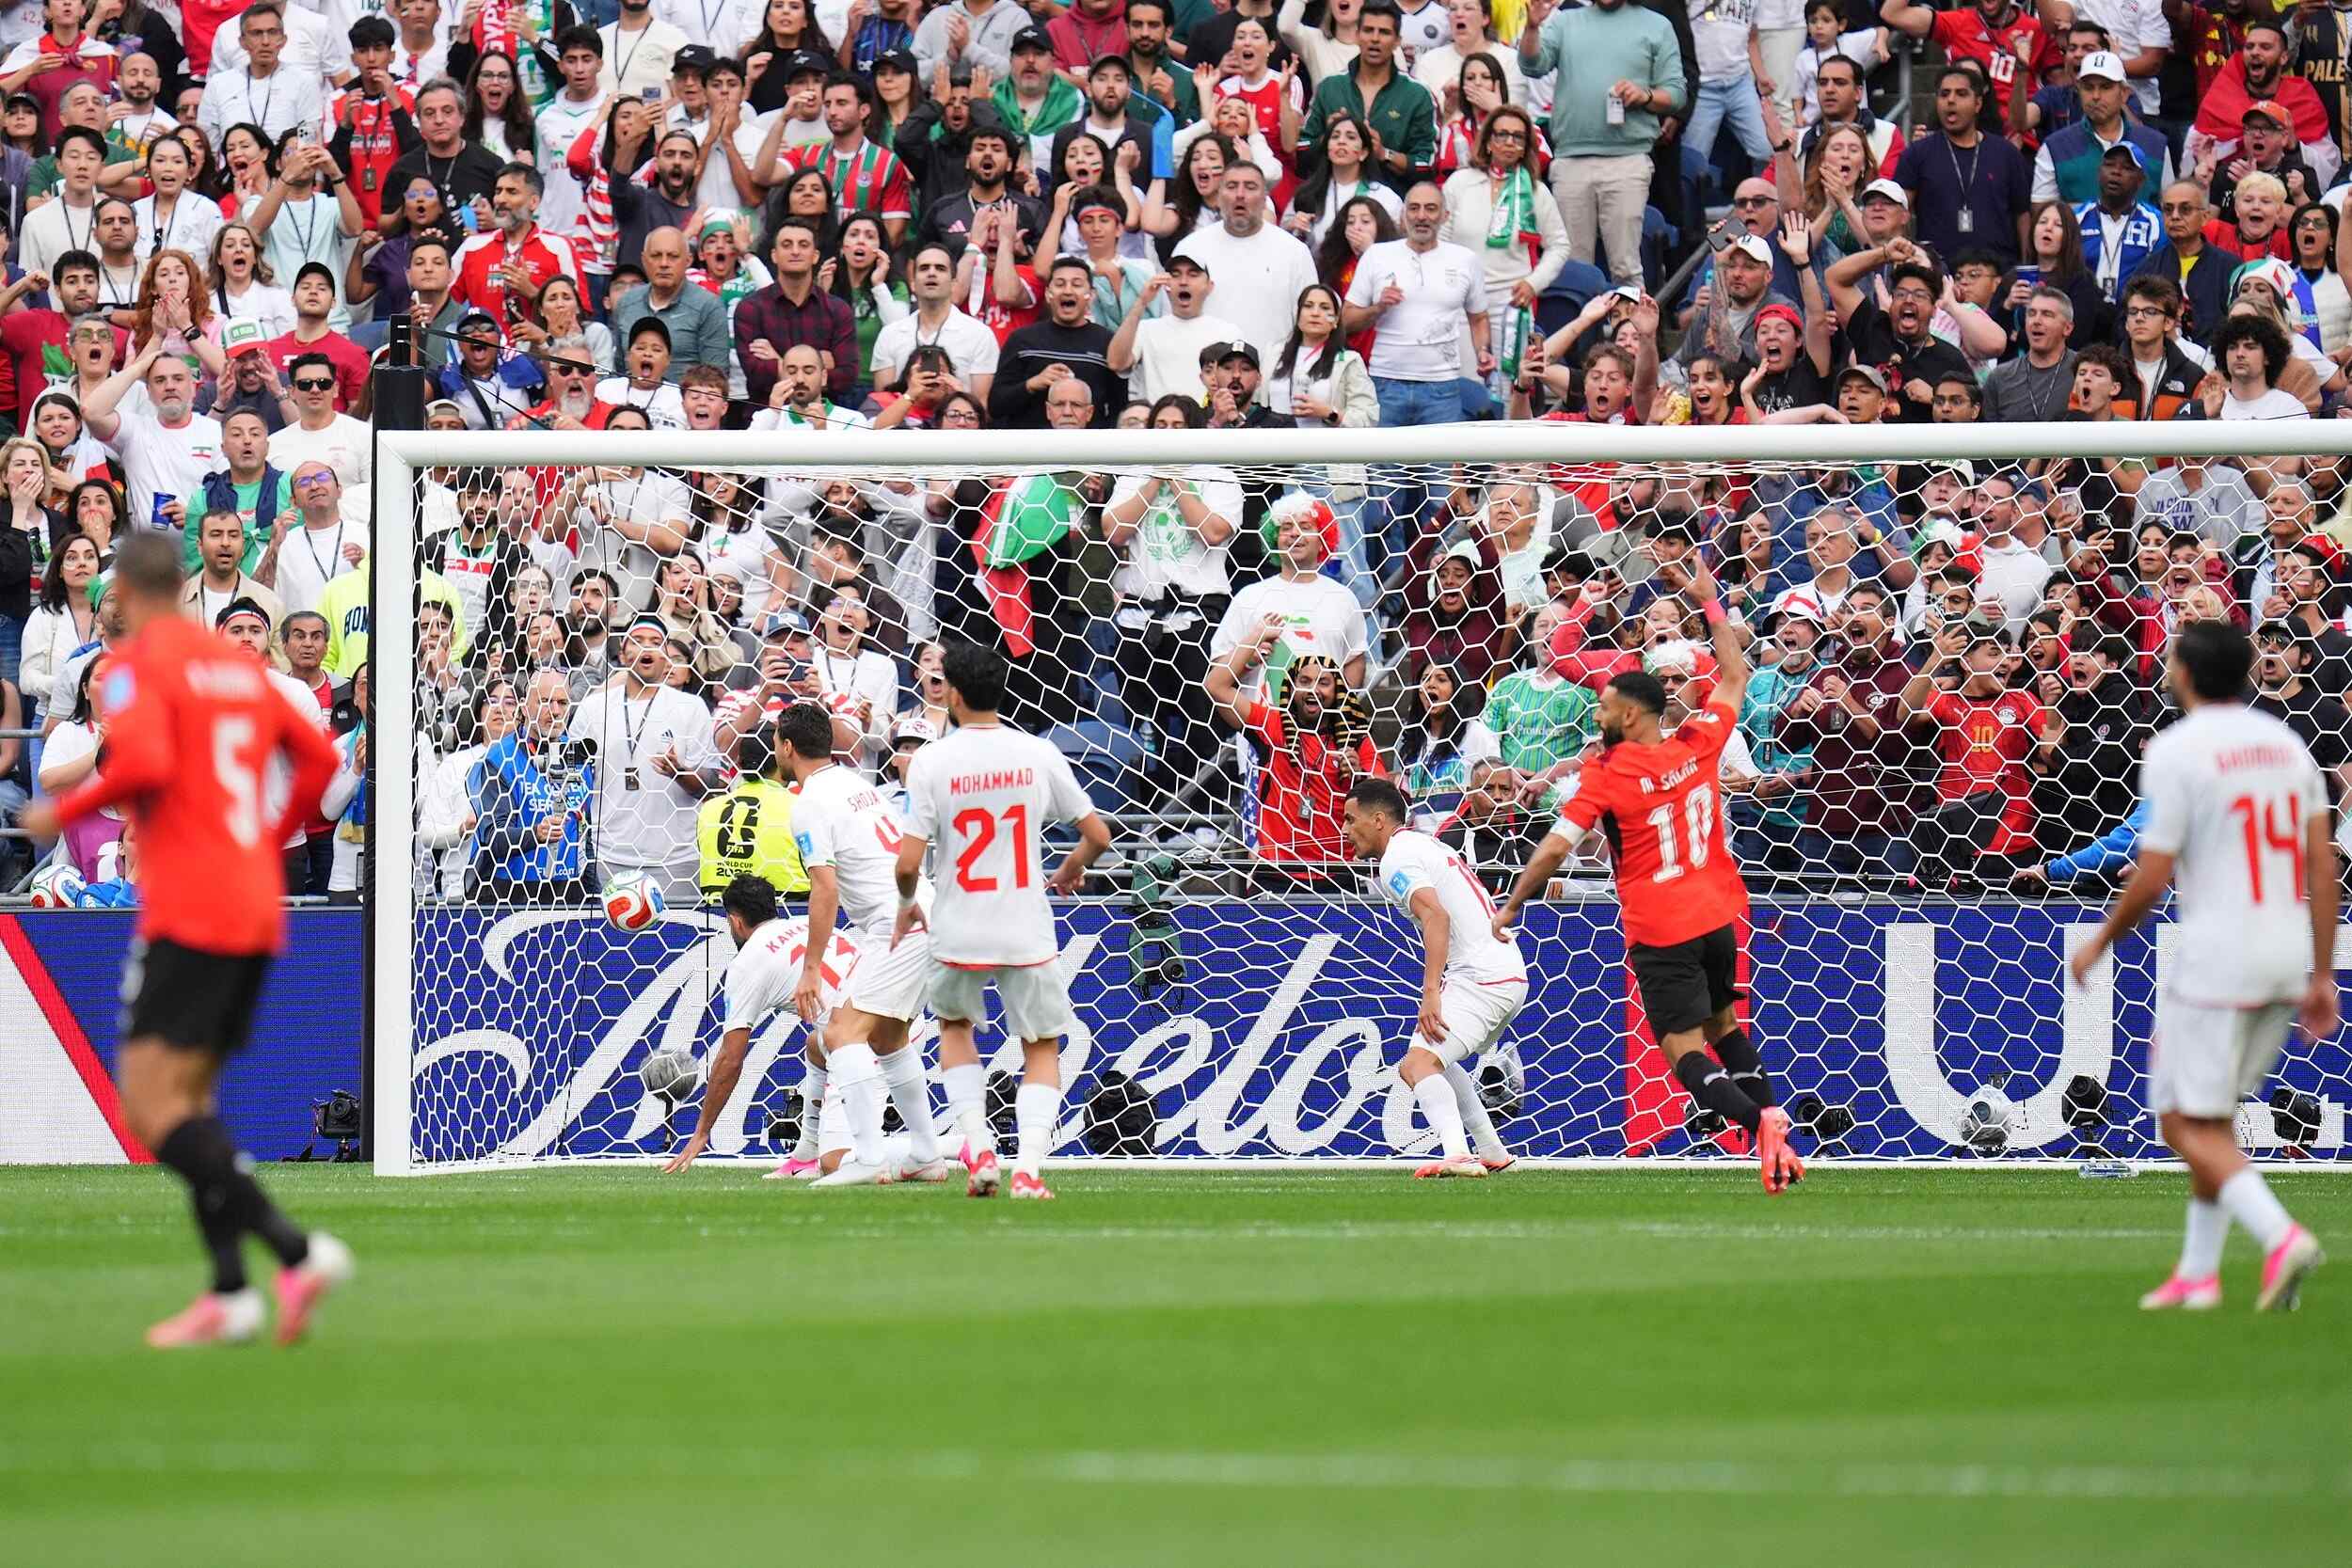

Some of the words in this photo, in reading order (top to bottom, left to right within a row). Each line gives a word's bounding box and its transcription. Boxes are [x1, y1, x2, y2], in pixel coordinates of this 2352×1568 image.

[1989, 50, 2017, 84] 10
[2304, 59, 2346, 82] PALE
[2123, 220, 2151, 247] H
[1971, 725, 1995, 753] 10
[212, 715, 260, 849] 5
[950, 768, 1034, 796] MOHAMMAD
[1660, 755, 1699, 792] SALAH
[847, 790, 881, 814] SHOJA
[952, 804, 1029, 893] 21
[1646, 782, 1714, 884] 10
[2230, 792, 2304, 904] 14
[726, 845, 745, 855] FIFA
